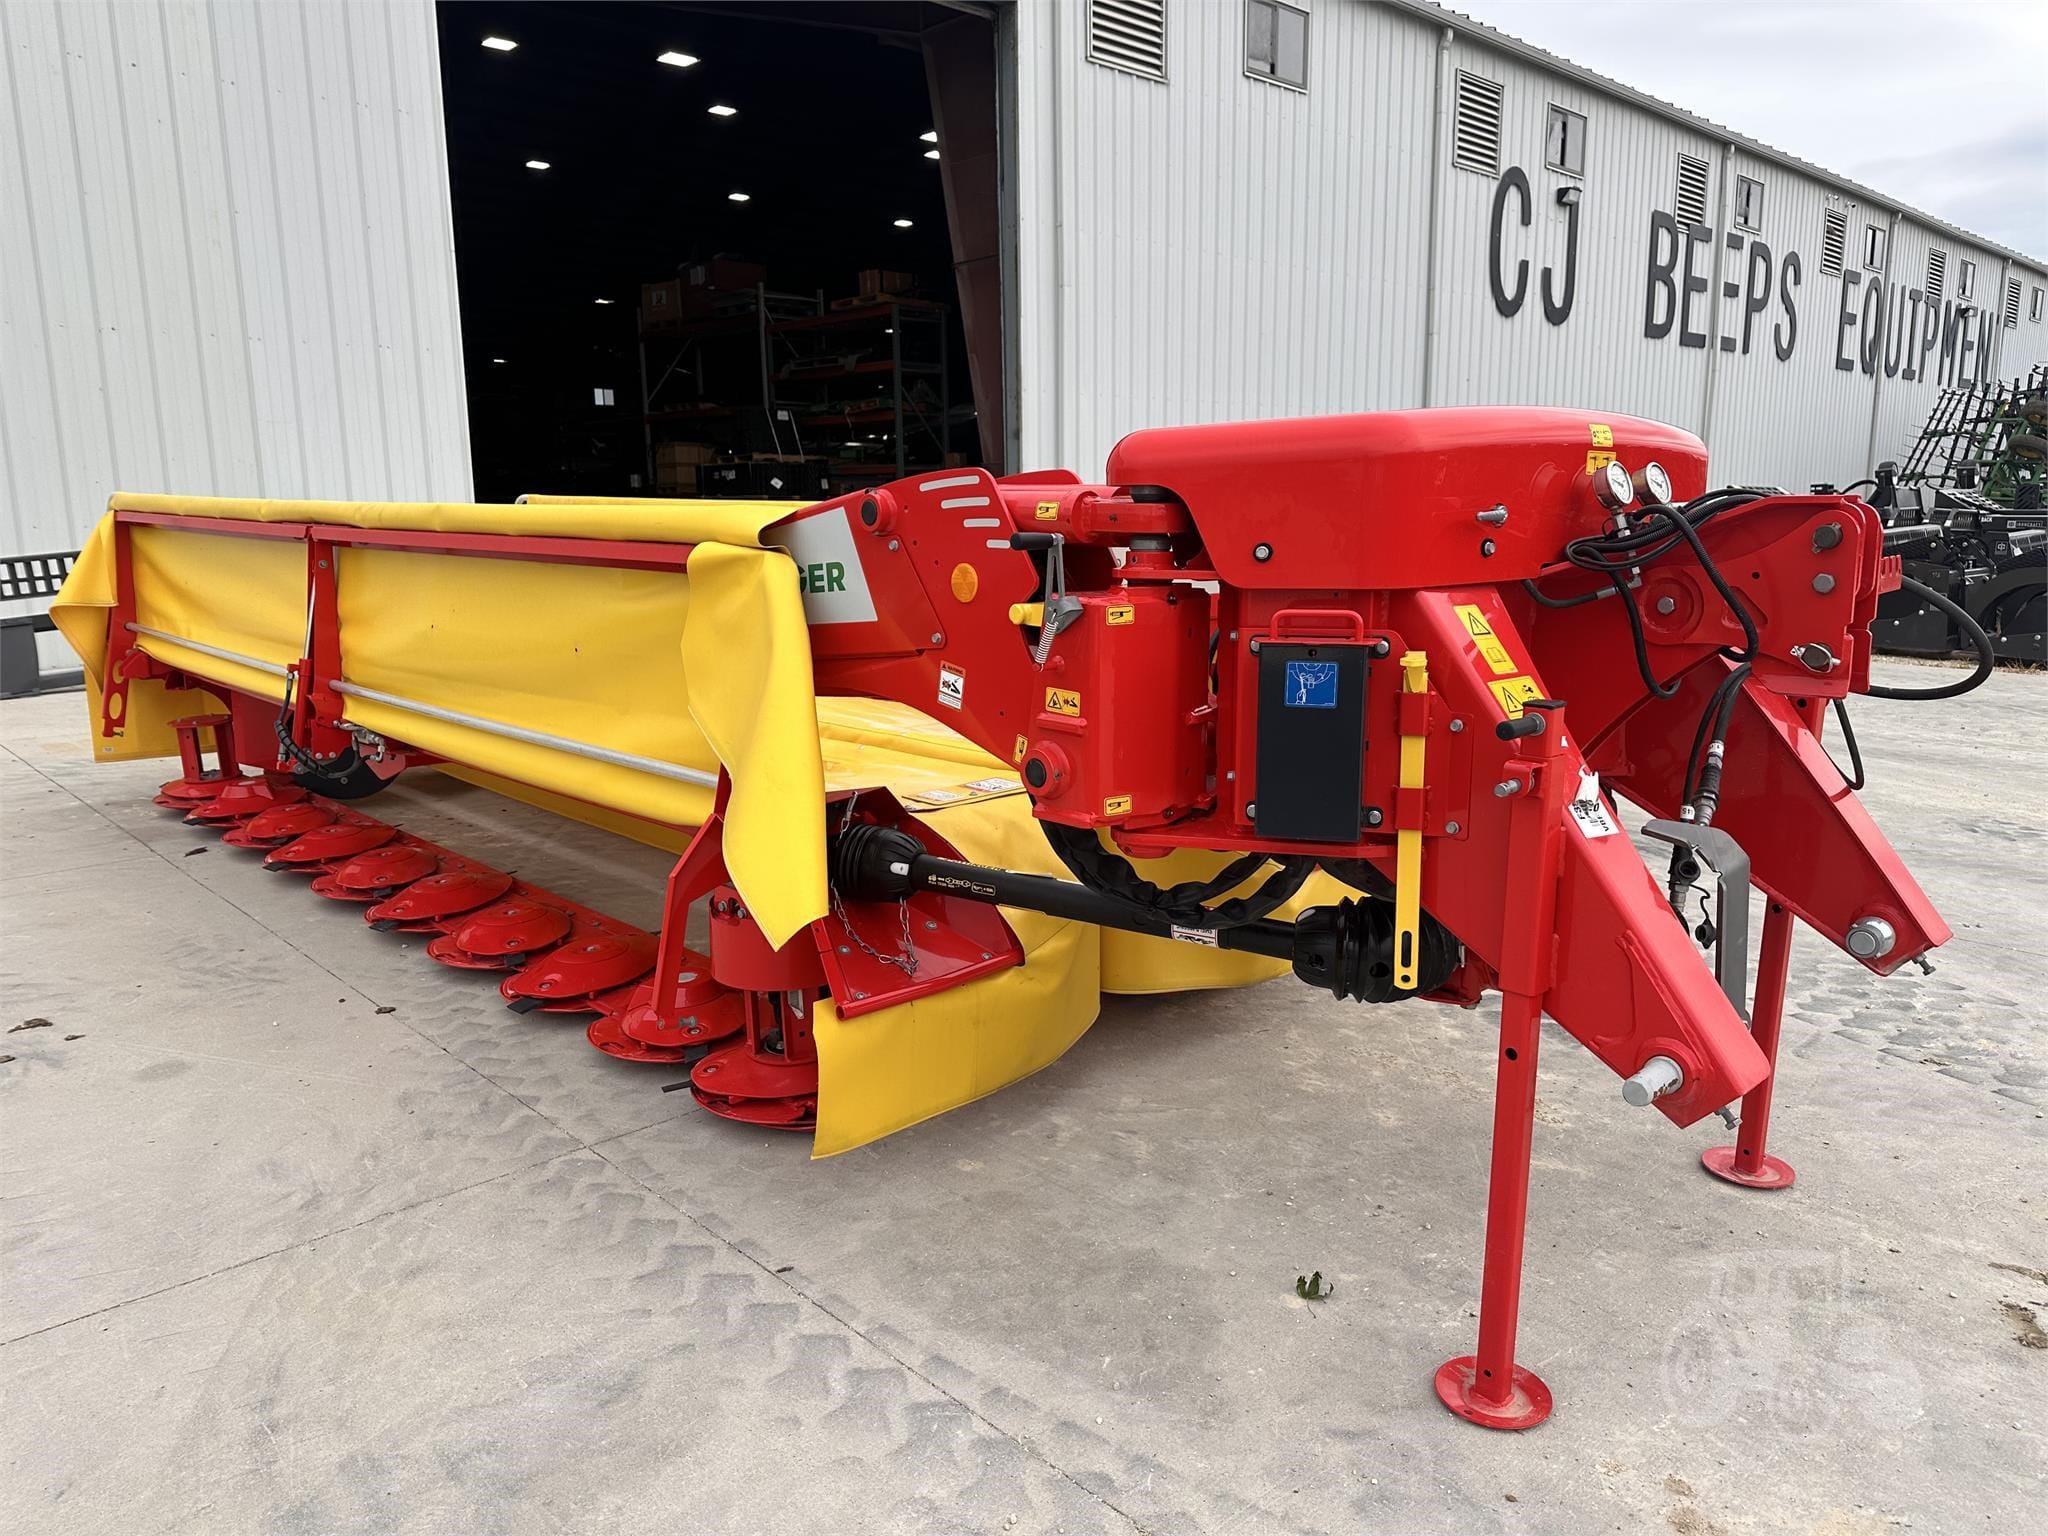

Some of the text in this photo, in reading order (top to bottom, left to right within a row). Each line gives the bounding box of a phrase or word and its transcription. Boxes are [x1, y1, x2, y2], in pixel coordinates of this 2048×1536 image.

[1489, 166, 2000, 391] CJ BEEPS EQUIPMEN
